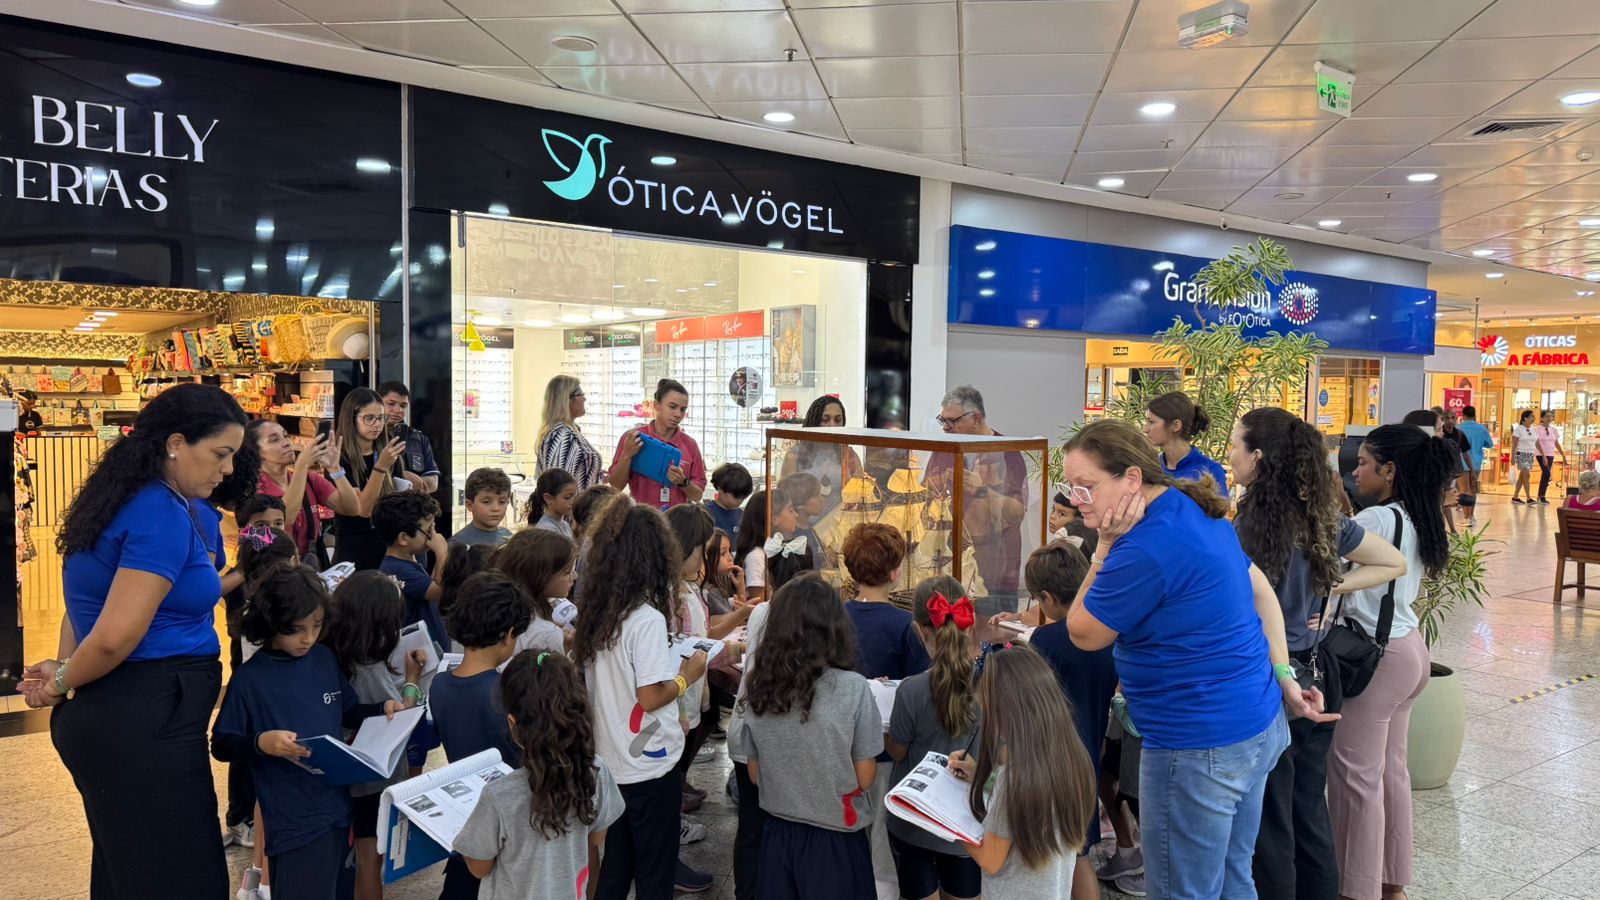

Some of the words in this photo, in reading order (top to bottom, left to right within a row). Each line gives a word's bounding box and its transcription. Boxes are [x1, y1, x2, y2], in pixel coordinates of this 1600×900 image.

[32, 94, 220, 163] BELLY
[608, 165, 722, 219] ÓTICA
[731, 189, 844, 234] VÖGEL
[1219, 314, 1228, 325] by
[1525, 334, 1576, 348] ÓTICAS
[1508, 355, 1519, 366] A
[1522, 351, 1589, 366] FÁBRICA
